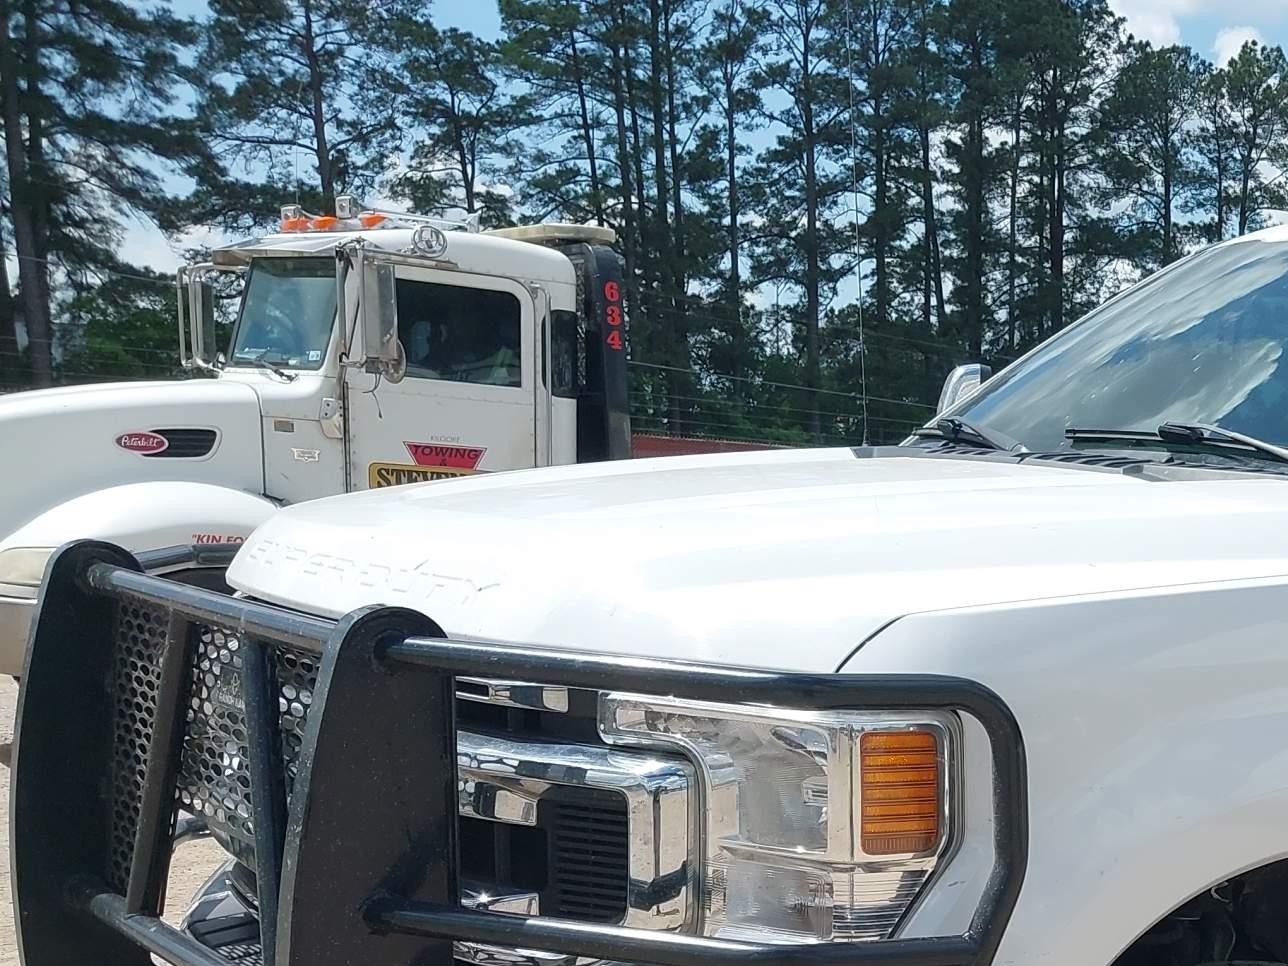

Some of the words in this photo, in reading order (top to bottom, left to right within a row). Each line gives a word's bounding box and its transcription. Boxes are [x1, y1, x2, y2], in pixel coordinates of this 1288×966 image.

[604, 281, 622, 350] 634
[121, 435, 161, 447] Peterbilt
[412, 444, 480, 460] TOWING
